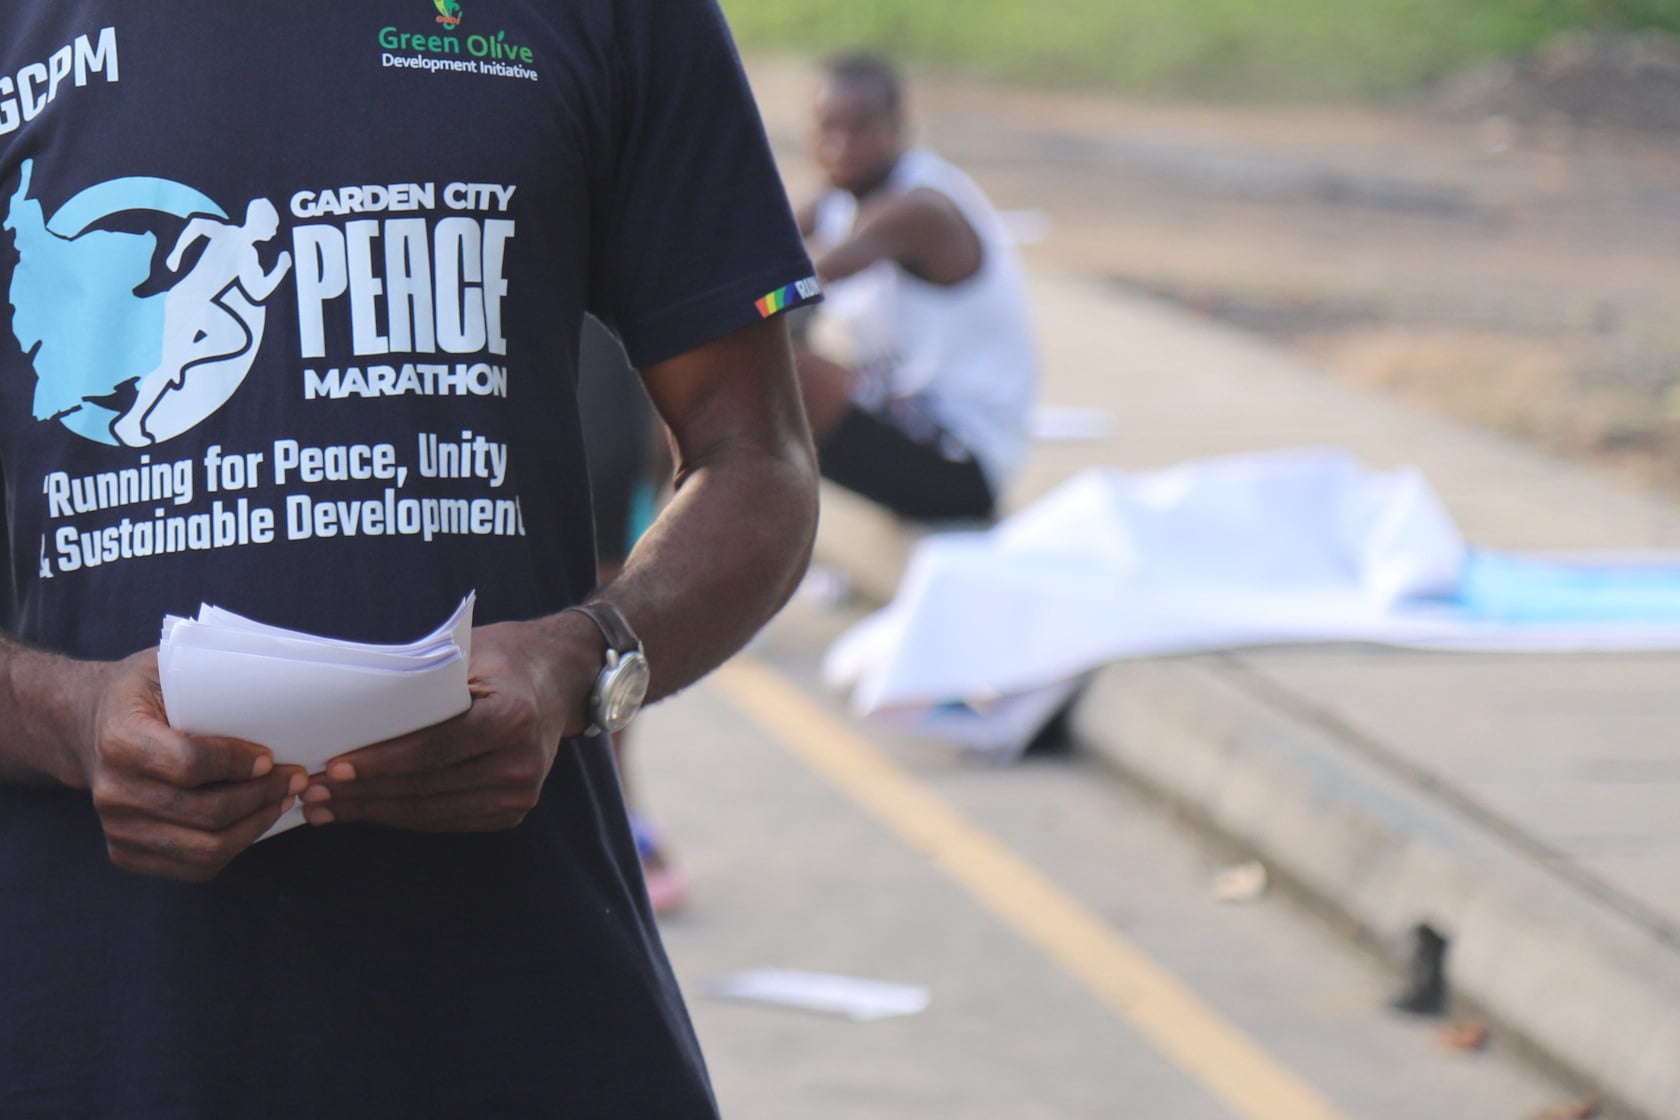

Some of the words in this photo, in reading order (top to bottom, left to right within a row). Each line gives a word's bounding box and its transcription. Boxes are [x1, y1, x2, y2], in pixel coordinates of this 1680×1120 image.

[378, 26, 460, 53] Green
[467, 30, 534, 63] Olive
[382, 53, 477, 73] Development
[480, 61, 538, 81] Initiative
[289, 182, 436, 219] GARDEN
[443, 181, 517, 212] CITY
[292, 216, 516, 359] PEACE
[304, 362, 507, 401] MARATHON
[204, 444, 263, 493] for
[273, 438, 409, 488] Peace,
[418, 430, 507, 488] Unity
[55, 498, 275, 573] Sustainable
